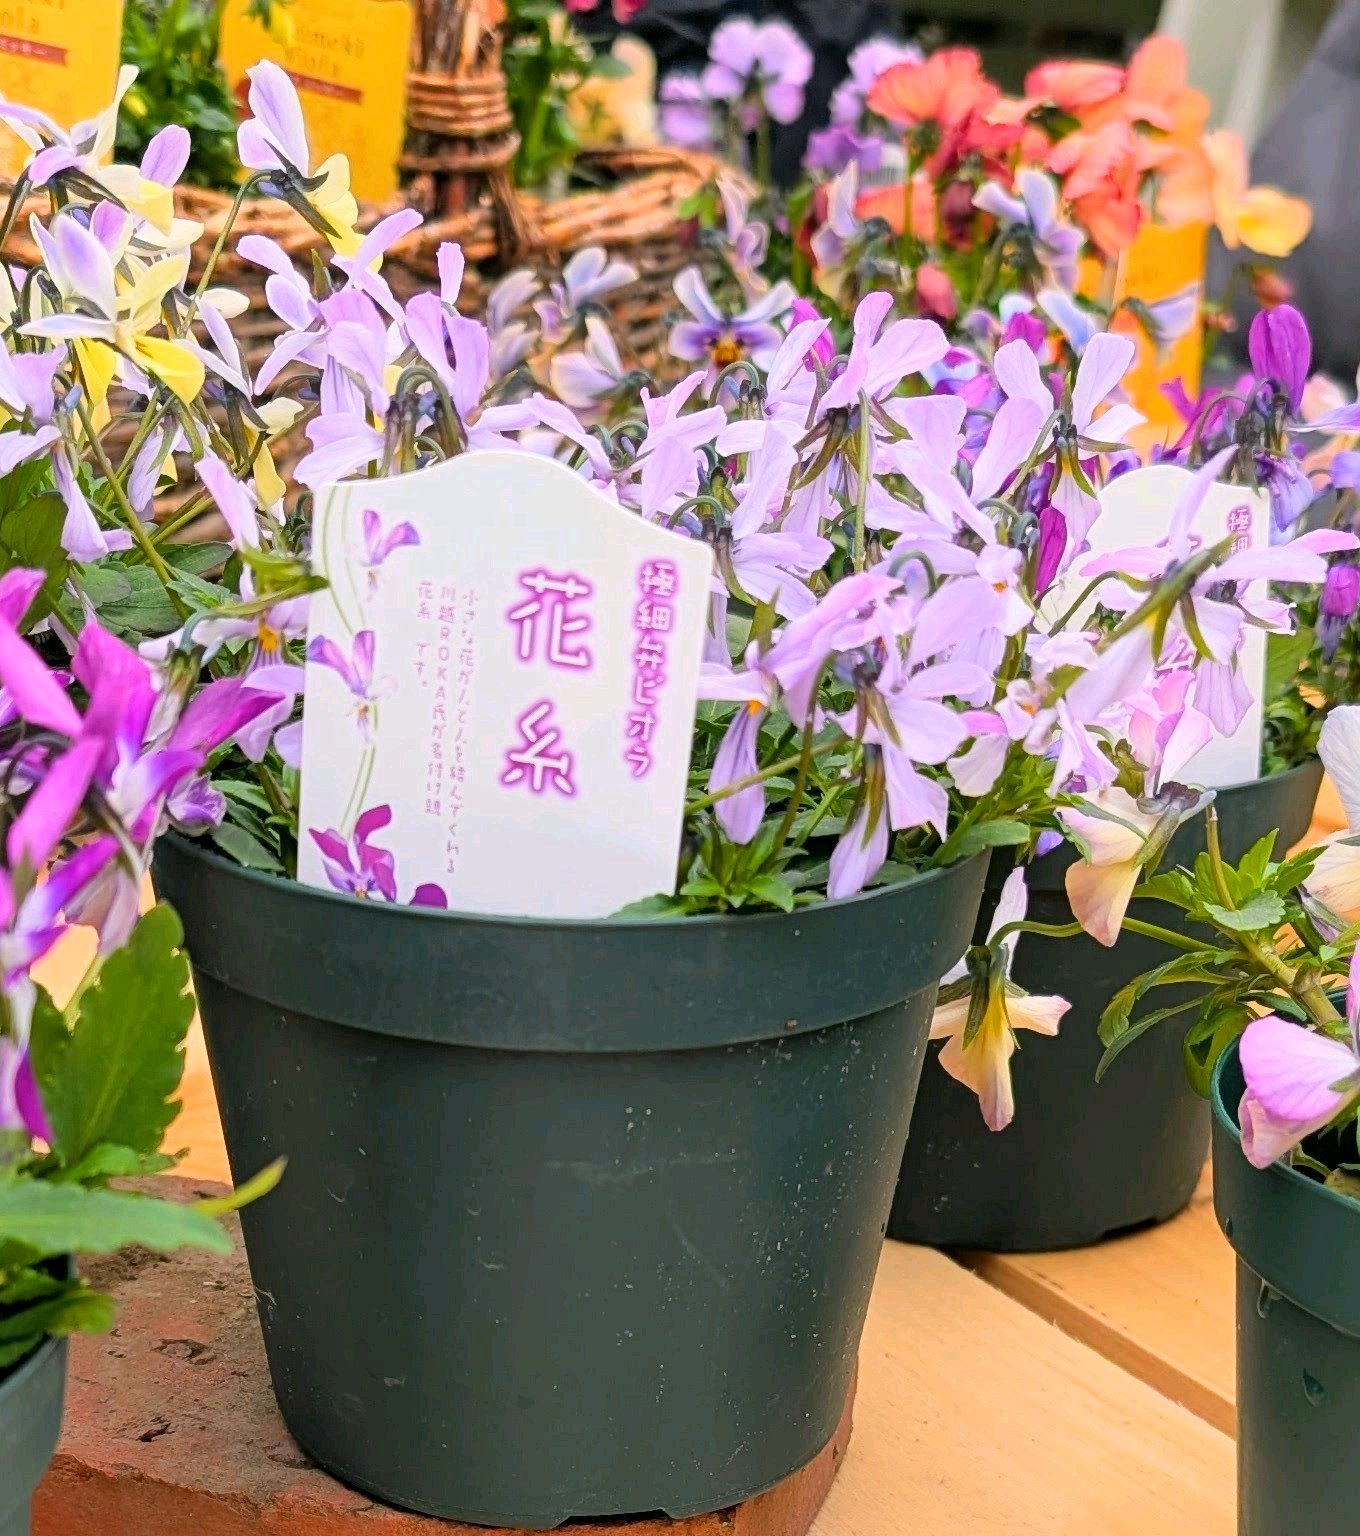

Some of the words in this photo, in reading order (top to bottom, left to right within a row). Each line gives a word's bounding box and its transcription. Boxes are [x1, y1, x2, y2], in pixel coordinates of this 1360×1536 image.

[502, 571, 594, 796] 花糸
[622, 560, 676, 779] 極細弁ビオラ
